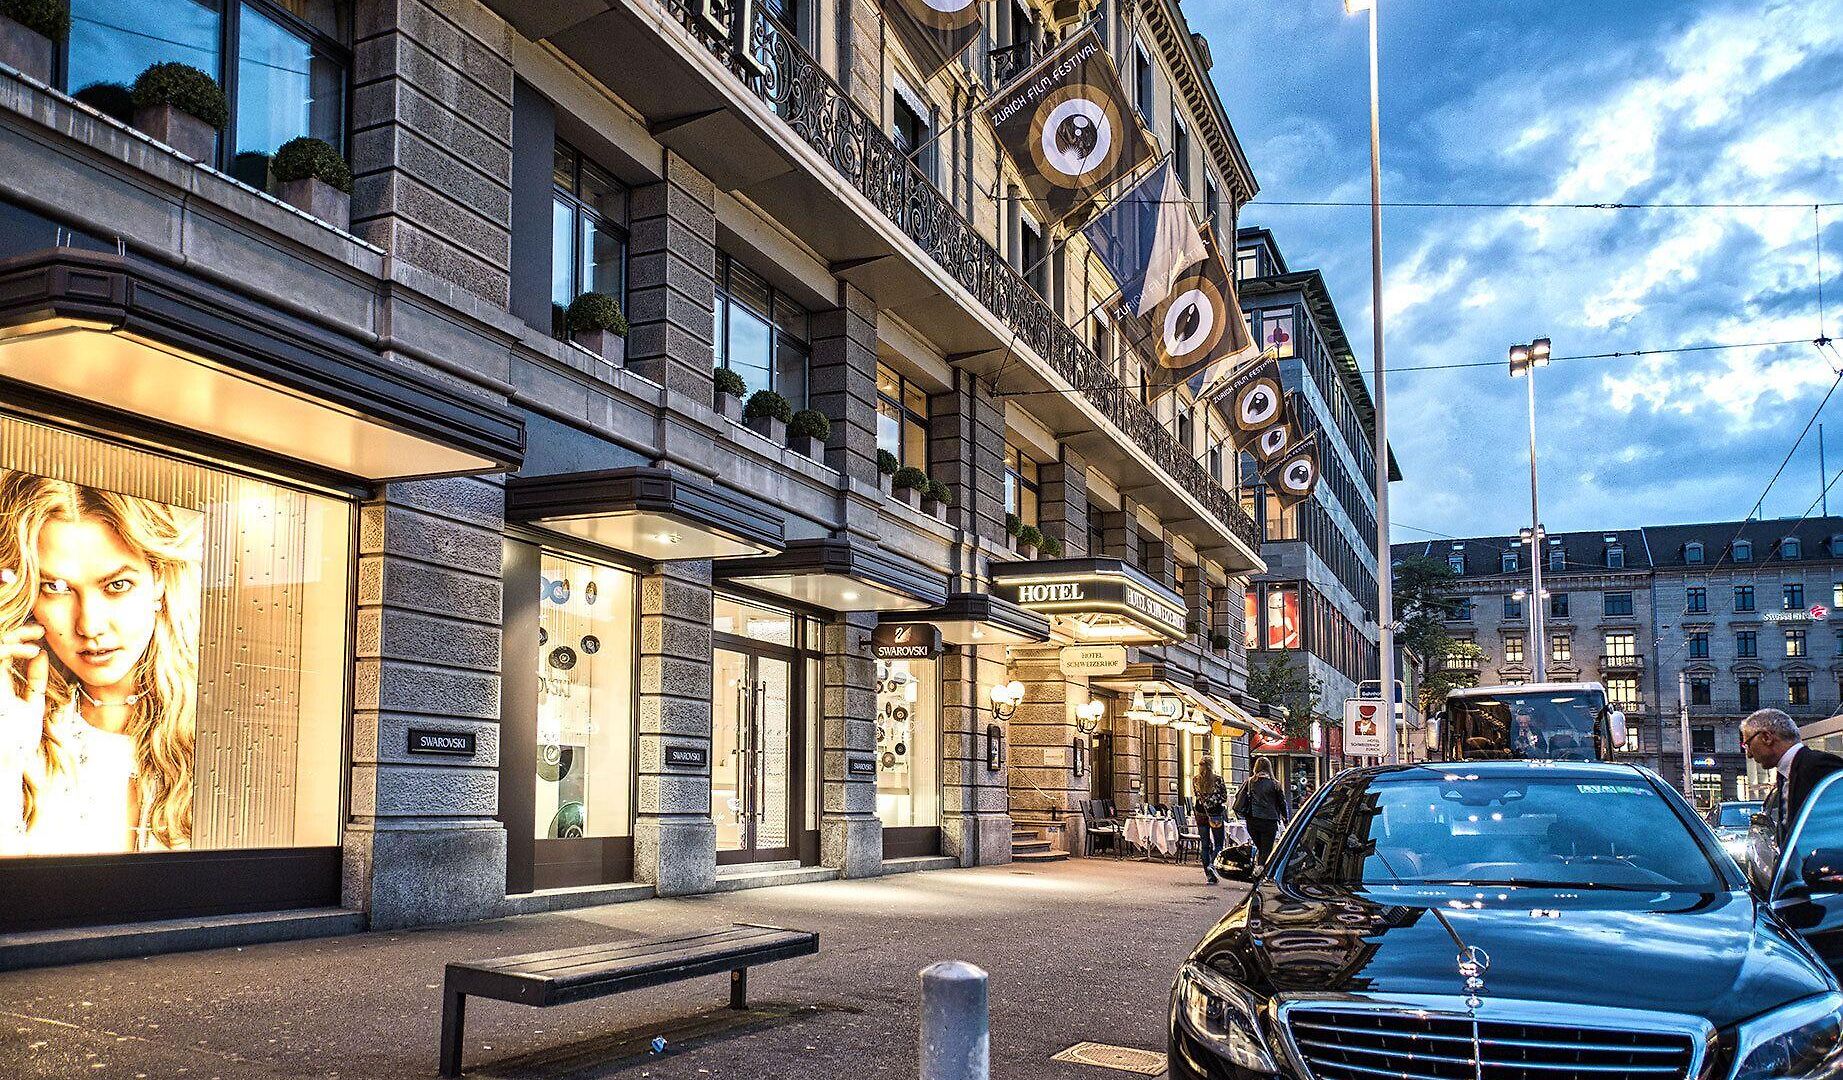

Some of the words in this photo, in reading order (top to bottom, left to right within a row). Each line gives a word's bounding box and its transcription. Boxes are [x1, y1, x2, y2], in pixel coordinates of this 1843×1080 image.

[992, 95, 1028, 127] ZURICH
[1027, 76, 1053, 101] FILM
[1052, 42, 1099, 82] FESTIVAL
[1213, 386, 1234, 404] ZURICH
[1234, 375, 1249, 389] FILM
[1248, 358, 1275, 378] FESTIVAL
[1018, 583, 1085, 603] HOTEL
[1127, 587, 1147, 612] HOTEL
[878, 645, 928, 657] SWAROVSKI
[1066, 660, 1119, 668] SCHWEIZERHOF
[420, 736, 466, 749] SWAROVSKI
